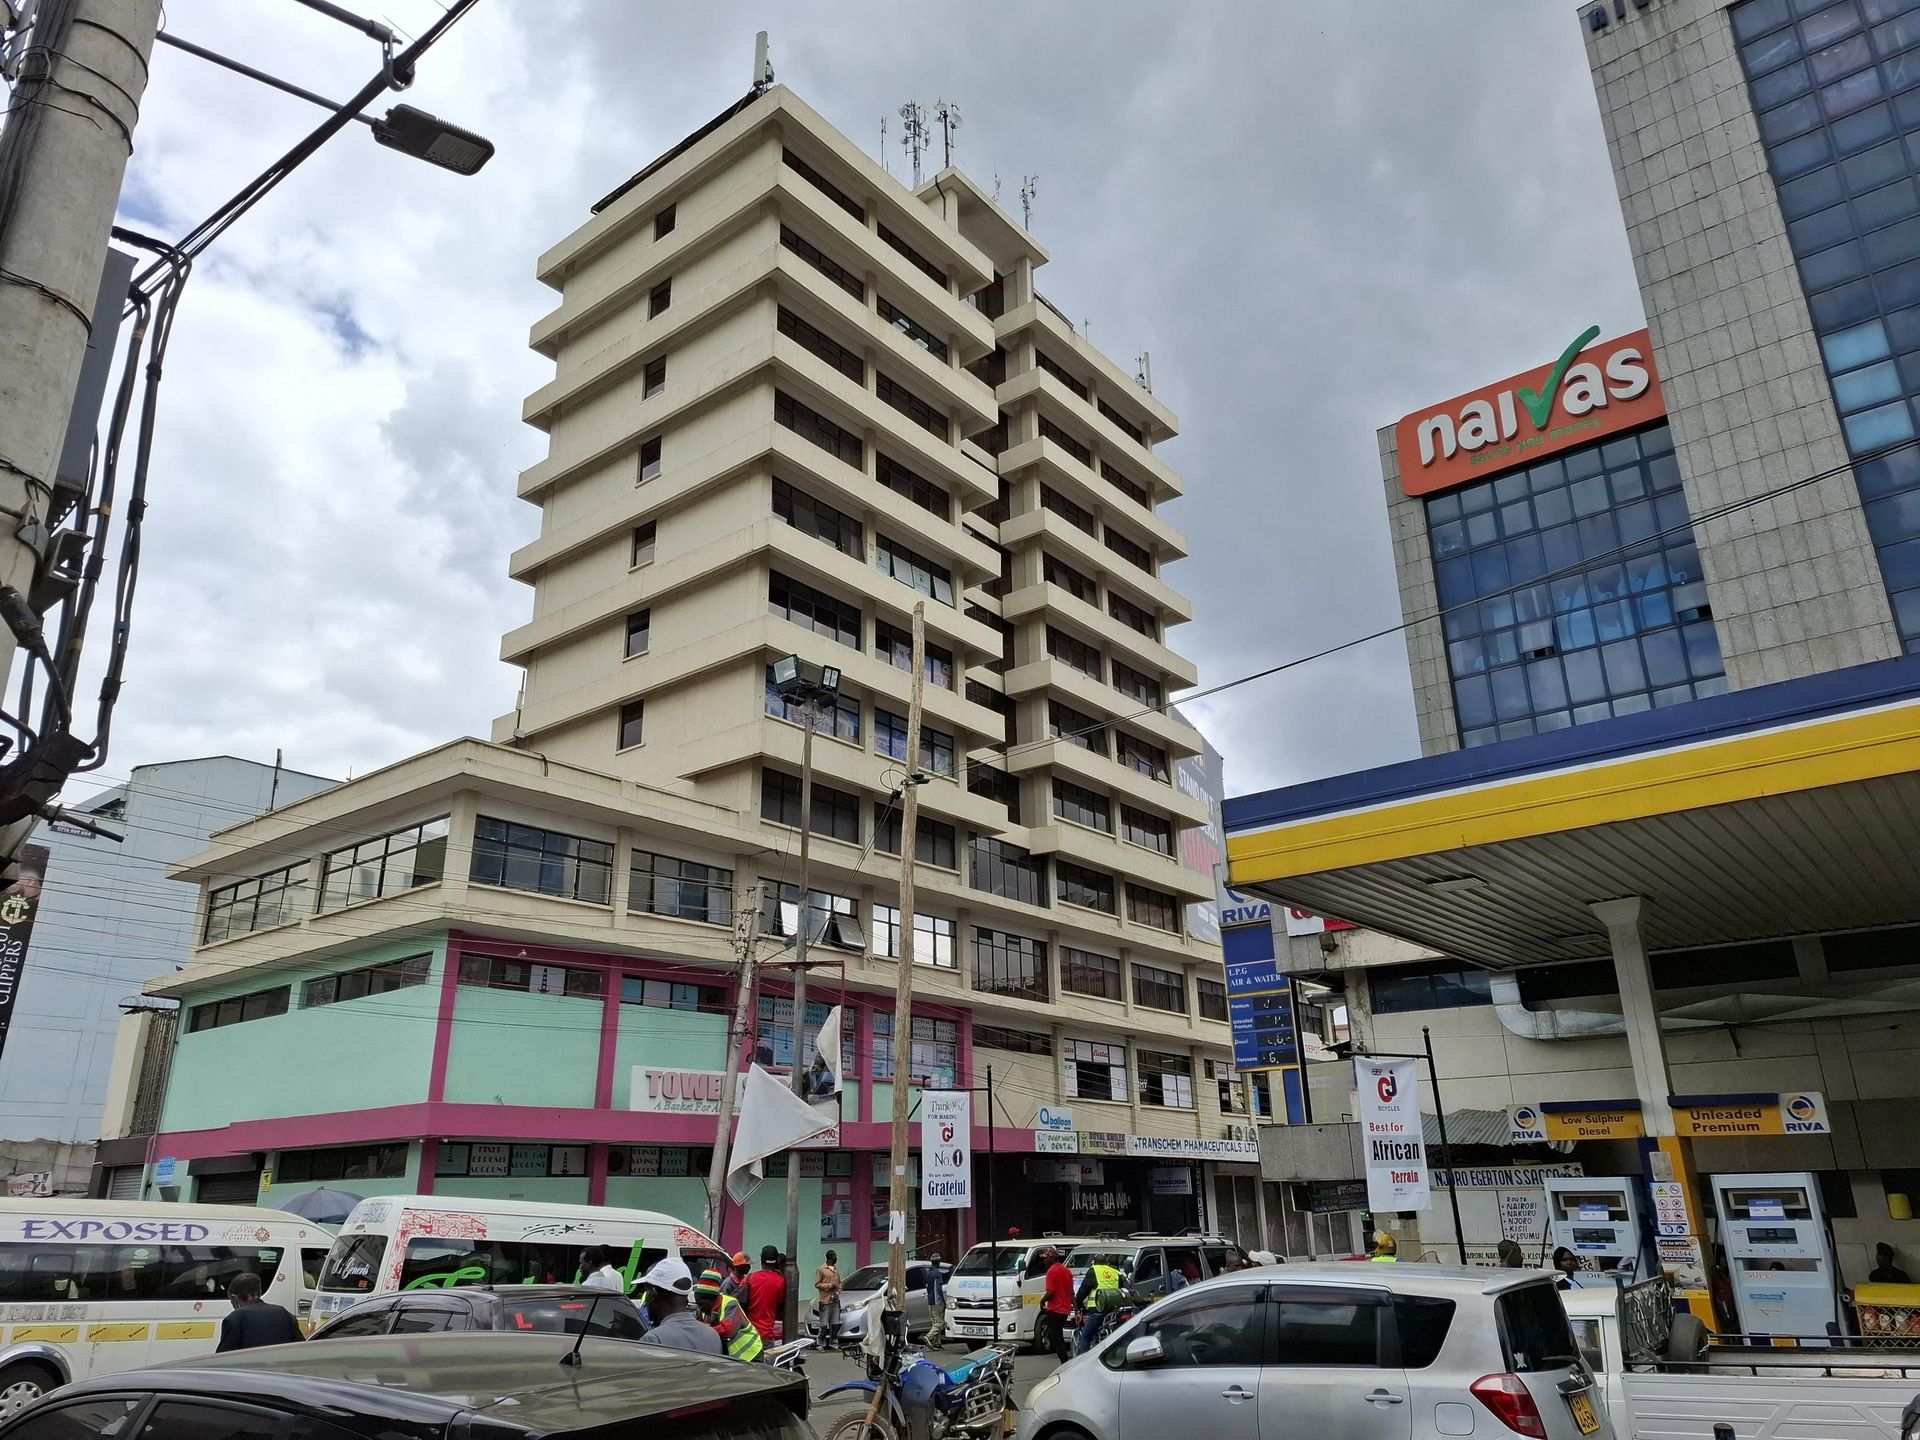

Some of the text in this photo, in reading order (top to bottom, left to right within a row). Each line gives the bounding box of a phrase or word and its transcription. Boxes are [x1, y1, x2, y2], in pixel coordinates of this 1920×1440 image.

[1417, 325, 1650, 468] naivas
[1516, 436, 1544, 453] you
[1549, 418, 1601, 440] money
[1178, 767, 1200, 801] STAND
[1222, 904, 1271, 924] RIVA
[0, 939, 22, 1005] CLIPPERS
[1231, 973, 1282, 986] AIR & WATER
[645, 1070, 725, 1100] TOWE
[654, 1100, 662, 1110] A
[664, 1101, 692, 1112] Basket
[694, 1102, 711, 1112] For
[930, 1100, 950, 1113] Thank
[1562, 1114, 1625, 1126] Low Sulphur
[1690, 1108, 1762, 1121] Unleaded
[1370, 1122, 1404, 1132] Best for
[1578, 1126, 1610, 1136] Diesel
[1692, 1122, 1760, 1133] Premium
[1785, 1122, 1825, 1132] RIVA
[1512, 1130, 1544, 1139] RIVA
[1052, 1142, 1074, 1150] DENTAL
[1137, 1138, 1182, 1150] TRANSCHEM
[1184, 1140, 1242, 1153] PHAMACEUTICALS
[1372, 1140, 1420, 1161] African
[934, 1151, 952, 1167] No.
[1391, 1170, 1419, 1184] Terrain
[1434, 1171, 1468, 1187] NJRO
[1470, 1169, 1514, 1187] EGERTON
[928, 1180, 966, 1196] Grateful
[20, 1220, 209, 1242] EXPOSED
